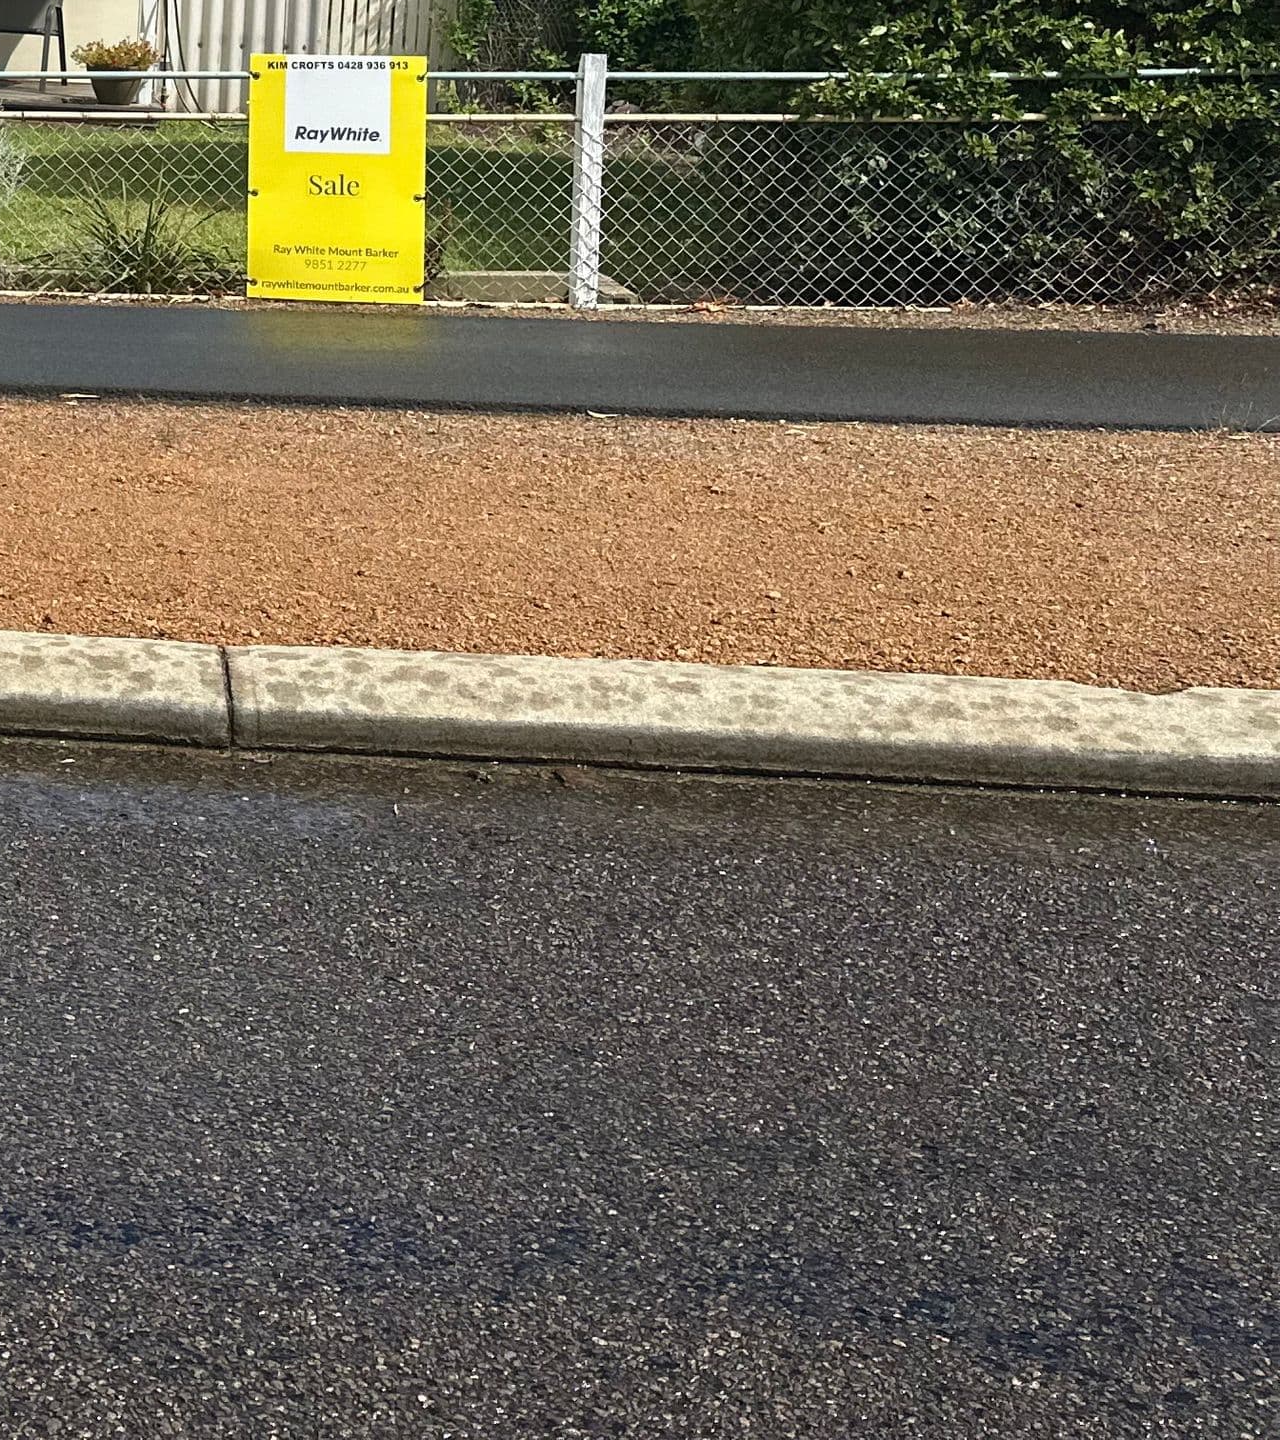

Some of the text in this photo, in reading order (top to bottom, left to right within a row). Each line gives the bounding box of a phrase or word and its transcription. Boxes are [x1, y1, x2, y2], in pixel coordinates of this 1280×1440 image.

[267, 61, 409, 70] KIM CROFTS 0428 936 913
[308, 173, 360, 196] Sale
[273, 244, 399, 258] Ray White Mount Barker
[304, 259, 367, 271] 9851 2277
[261, 280, 409, 294] raywhitemountbarker.com.au
